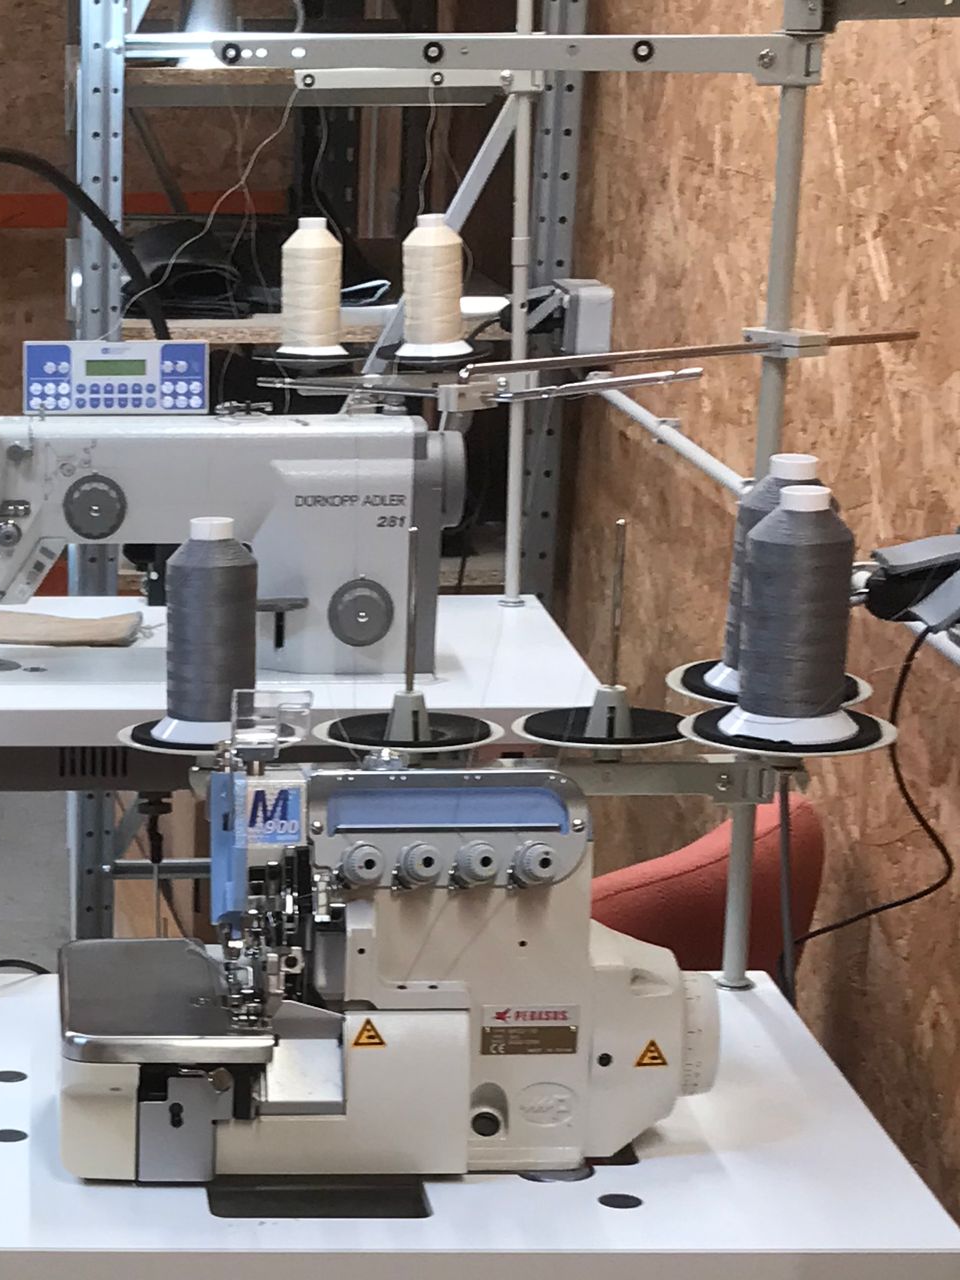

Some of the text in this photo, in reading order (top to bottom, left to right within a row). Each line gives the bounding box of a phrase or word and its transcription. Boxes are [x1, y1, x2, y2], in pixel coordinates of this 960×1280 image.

[361, 494, 407, 507] ADLER
[248, 789, 290, 828] M
[264, 820, 299, 834] 900
